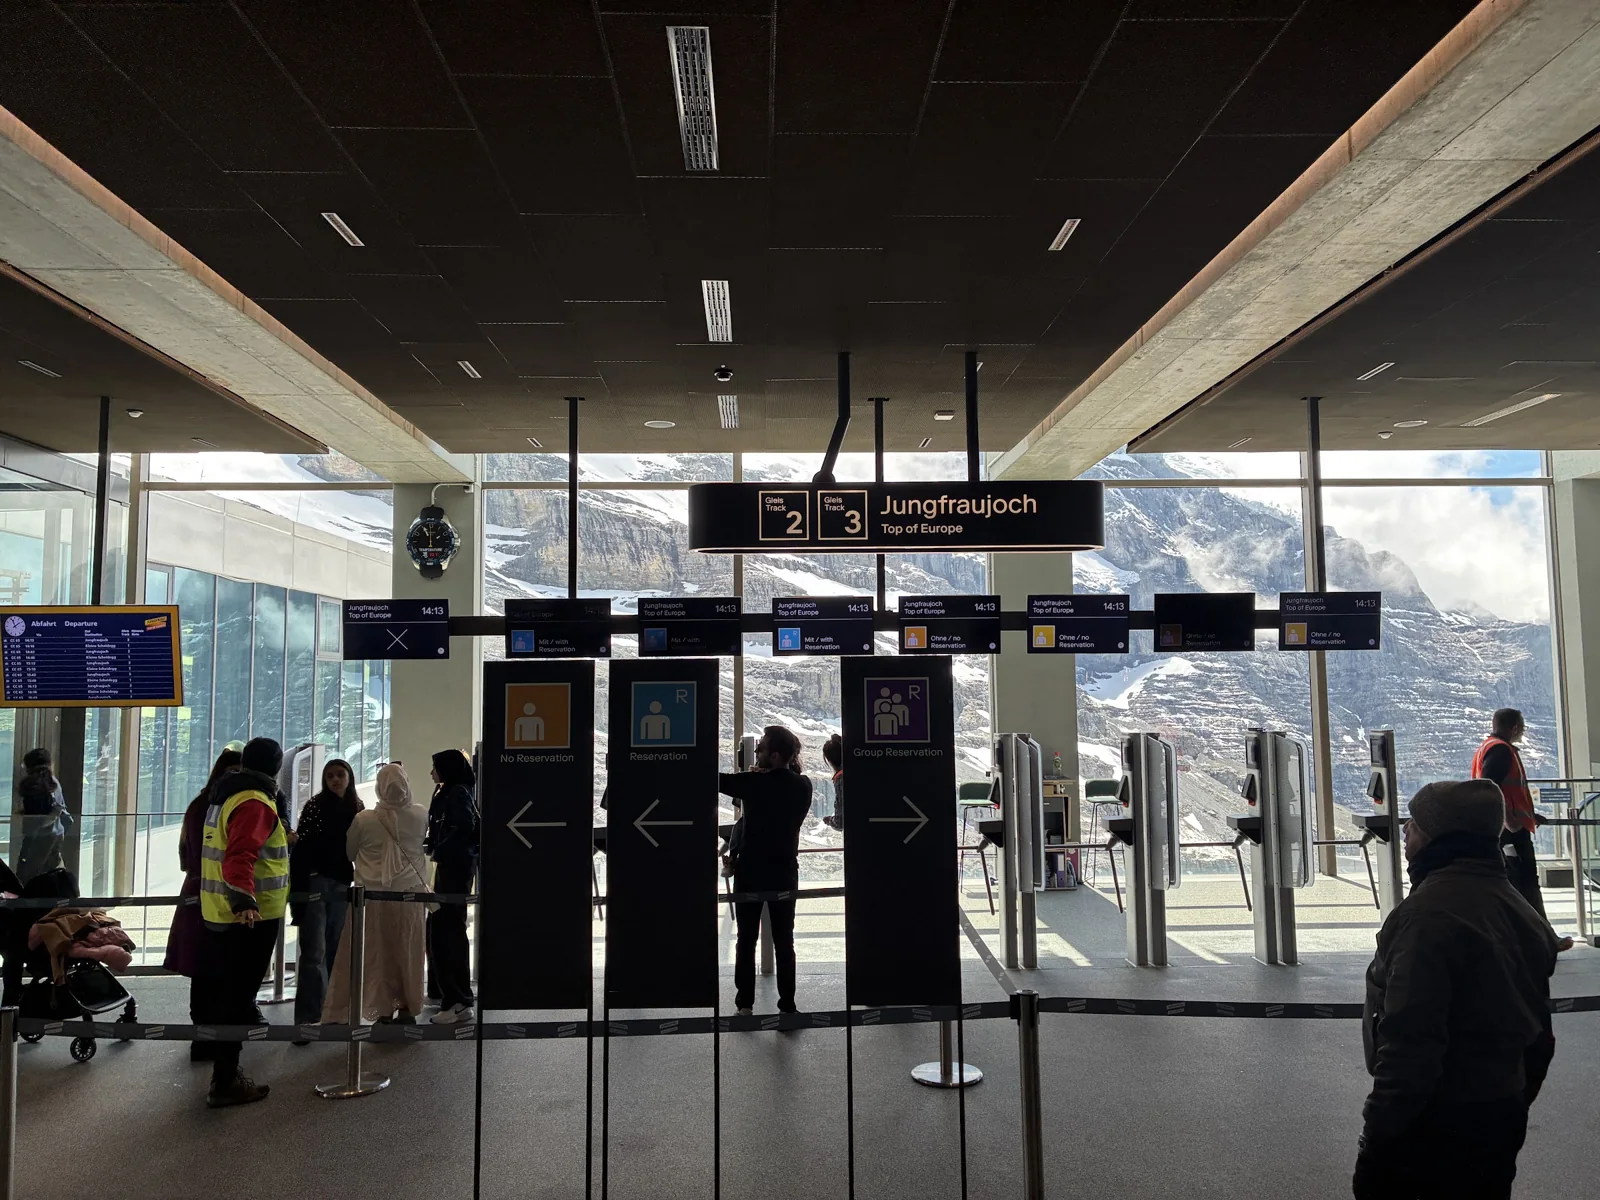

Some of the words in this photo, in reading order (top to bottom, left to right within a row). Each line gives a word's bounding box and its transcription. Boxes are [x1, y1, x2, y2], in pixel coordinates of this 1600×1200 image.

[880, 494, 1037, 519] Jungfraujoch
[786, 511, 802, 534] 2
[844, 510, 862, 534] 3
[881, 524, 901, 536] Top
[904, 523, 919, 534] of
[920, 524, 963, 536] Europe
[848, 604, 869, 612] 14:13
[974, 603, 996, 611] 14:13
[1103, 602, 1124, 611] 14:13
[1354, 599, 1376, 608] 14:13
[348, 604, 389, 612] Jungfraujoch
[421, 606, 444, 615] 14:13
[676, 689, 688, 704] R
[909, 685, 920, 700] R
[500, 754, 514, 762] No
[517, 754, 574, 762] Reservation
[630, 752, 688, 760] Reservation
[853, 748, 883, 758] Group
[886, 748, 943, 756] Reservation
